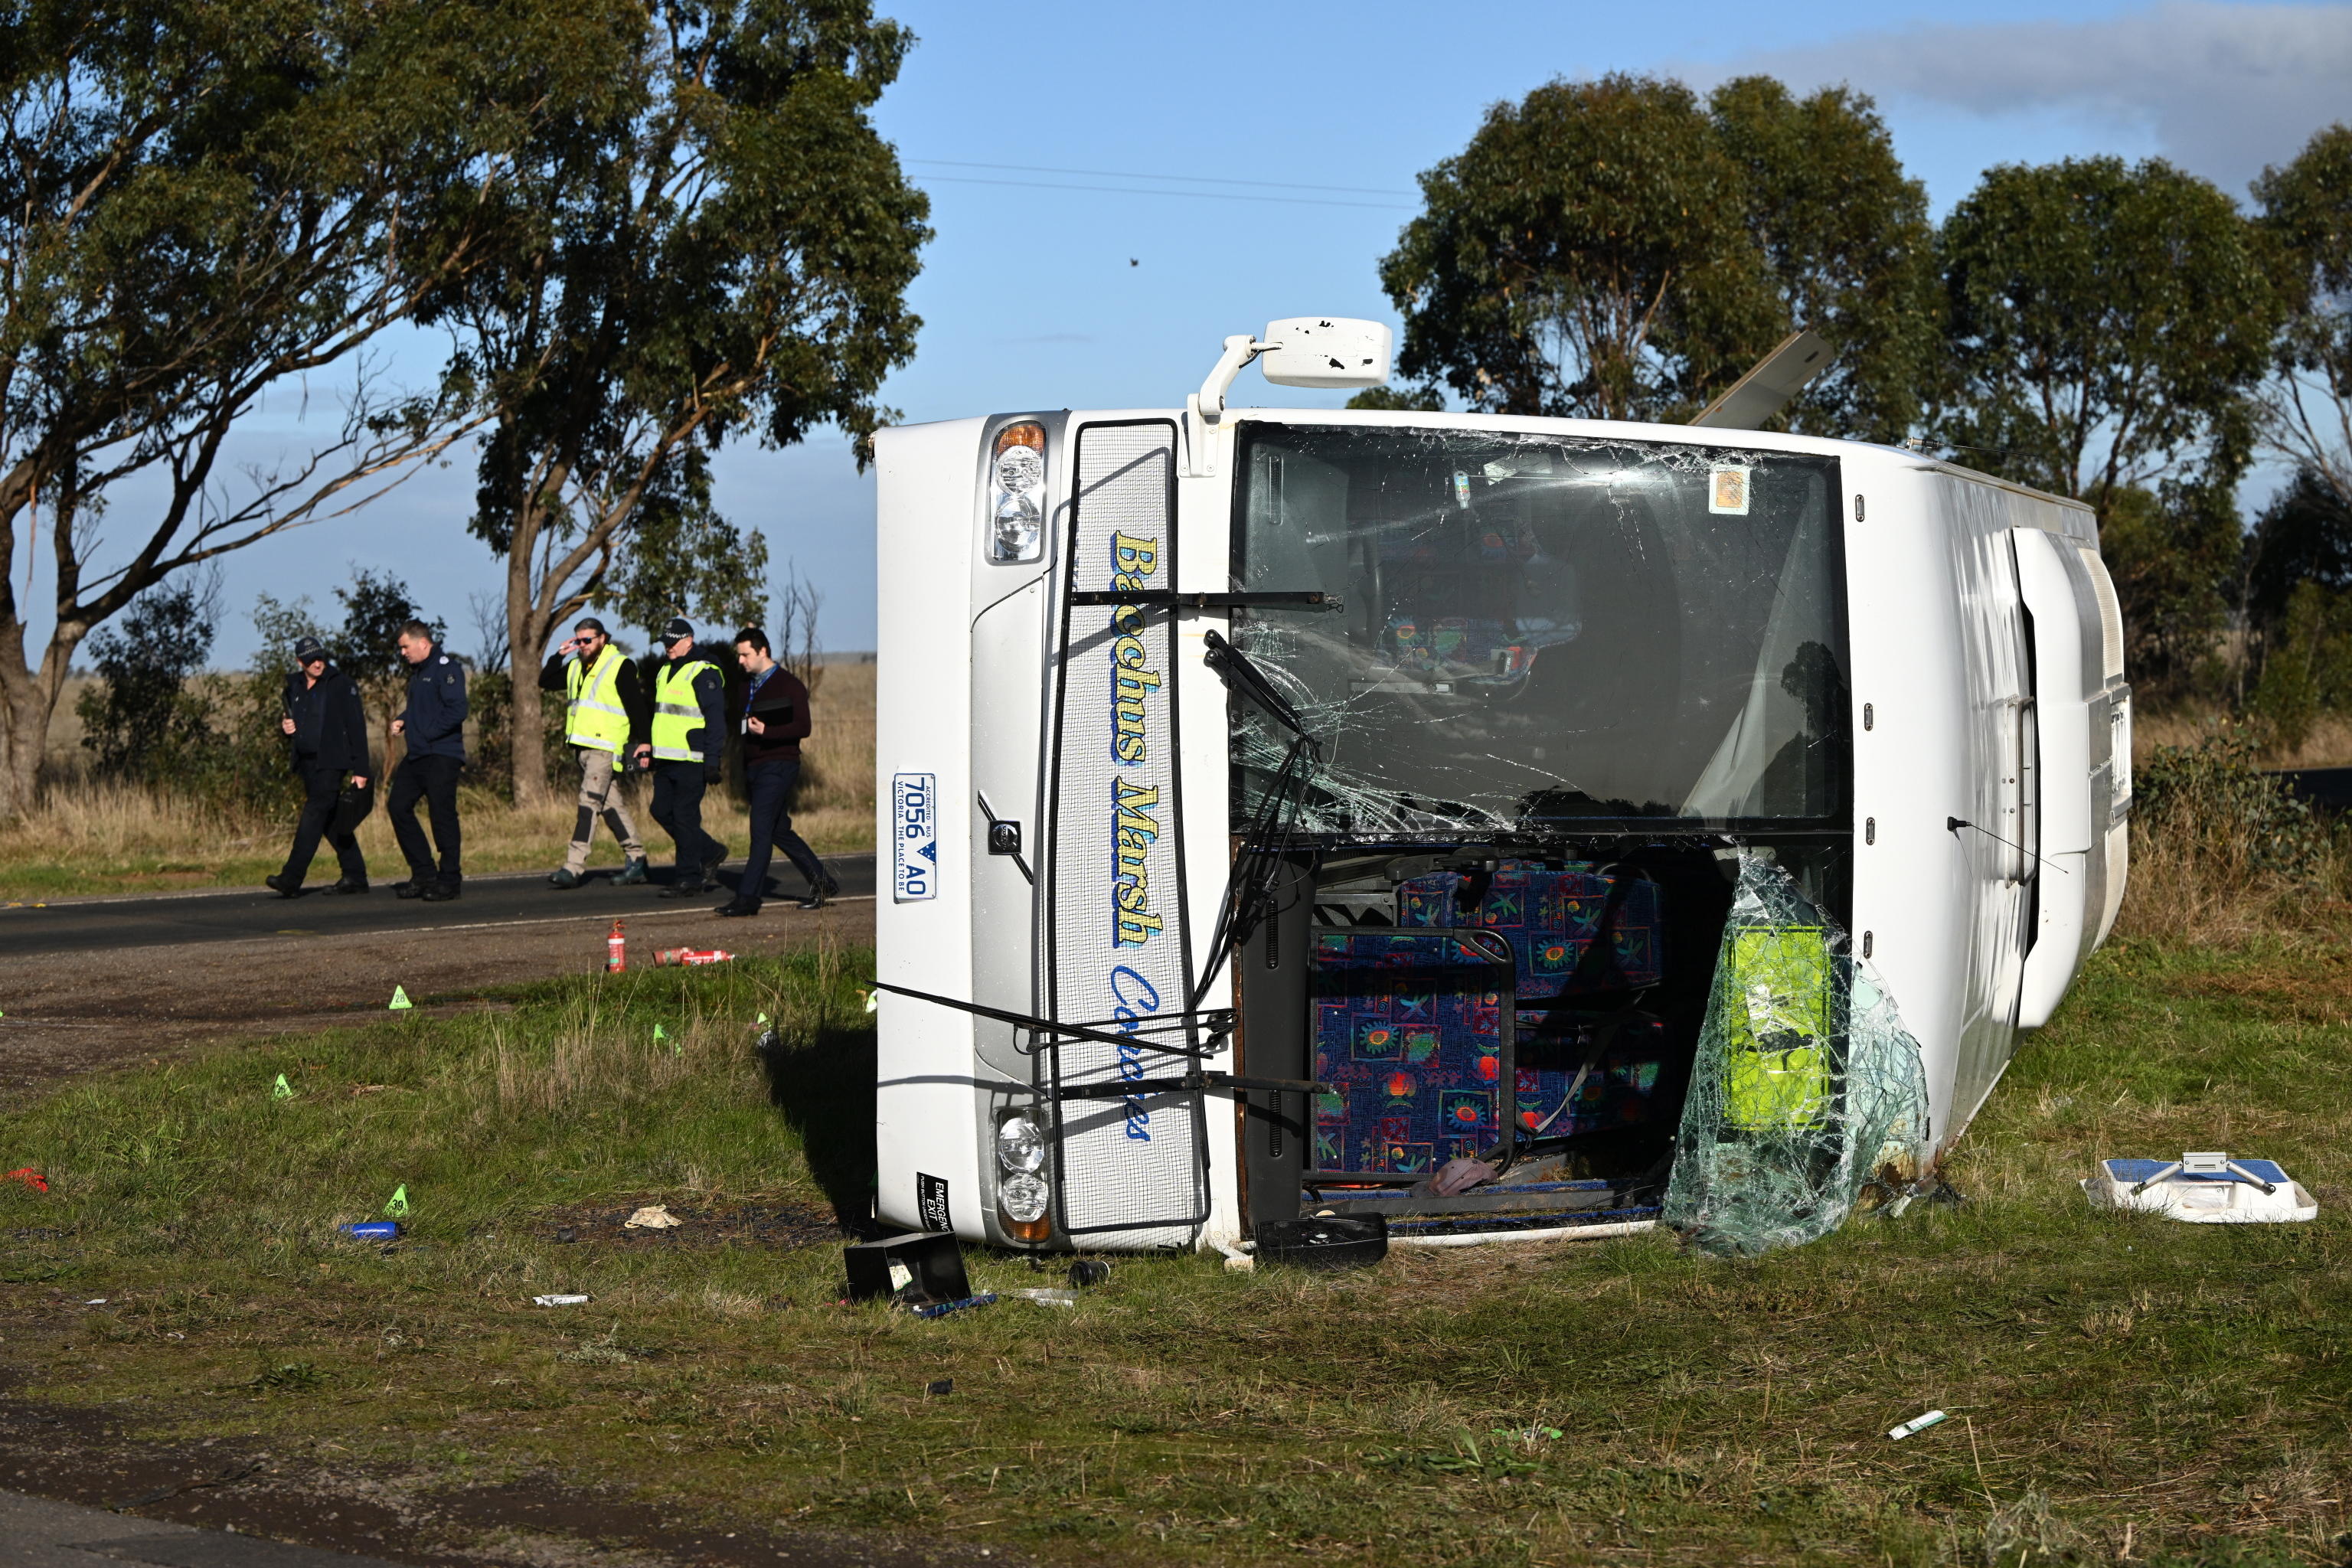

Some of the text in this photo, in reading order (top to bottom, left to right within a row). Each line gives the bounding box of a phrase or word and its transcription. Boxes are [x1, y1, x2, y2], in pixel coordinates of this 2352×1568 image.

[905, 776, 925, 839] 7056
[1111, 776, 1163, 948] Marsh
[898, 869, 904, 880] TO
[898, 882, 905, 891] BE
[395, 994, 405, 1003] 28
[392, 1199, 403, 1210] 39
[926, 1198, 938, 1221] EXIT
[936, 1182, 950, 1233] EMERGENC
